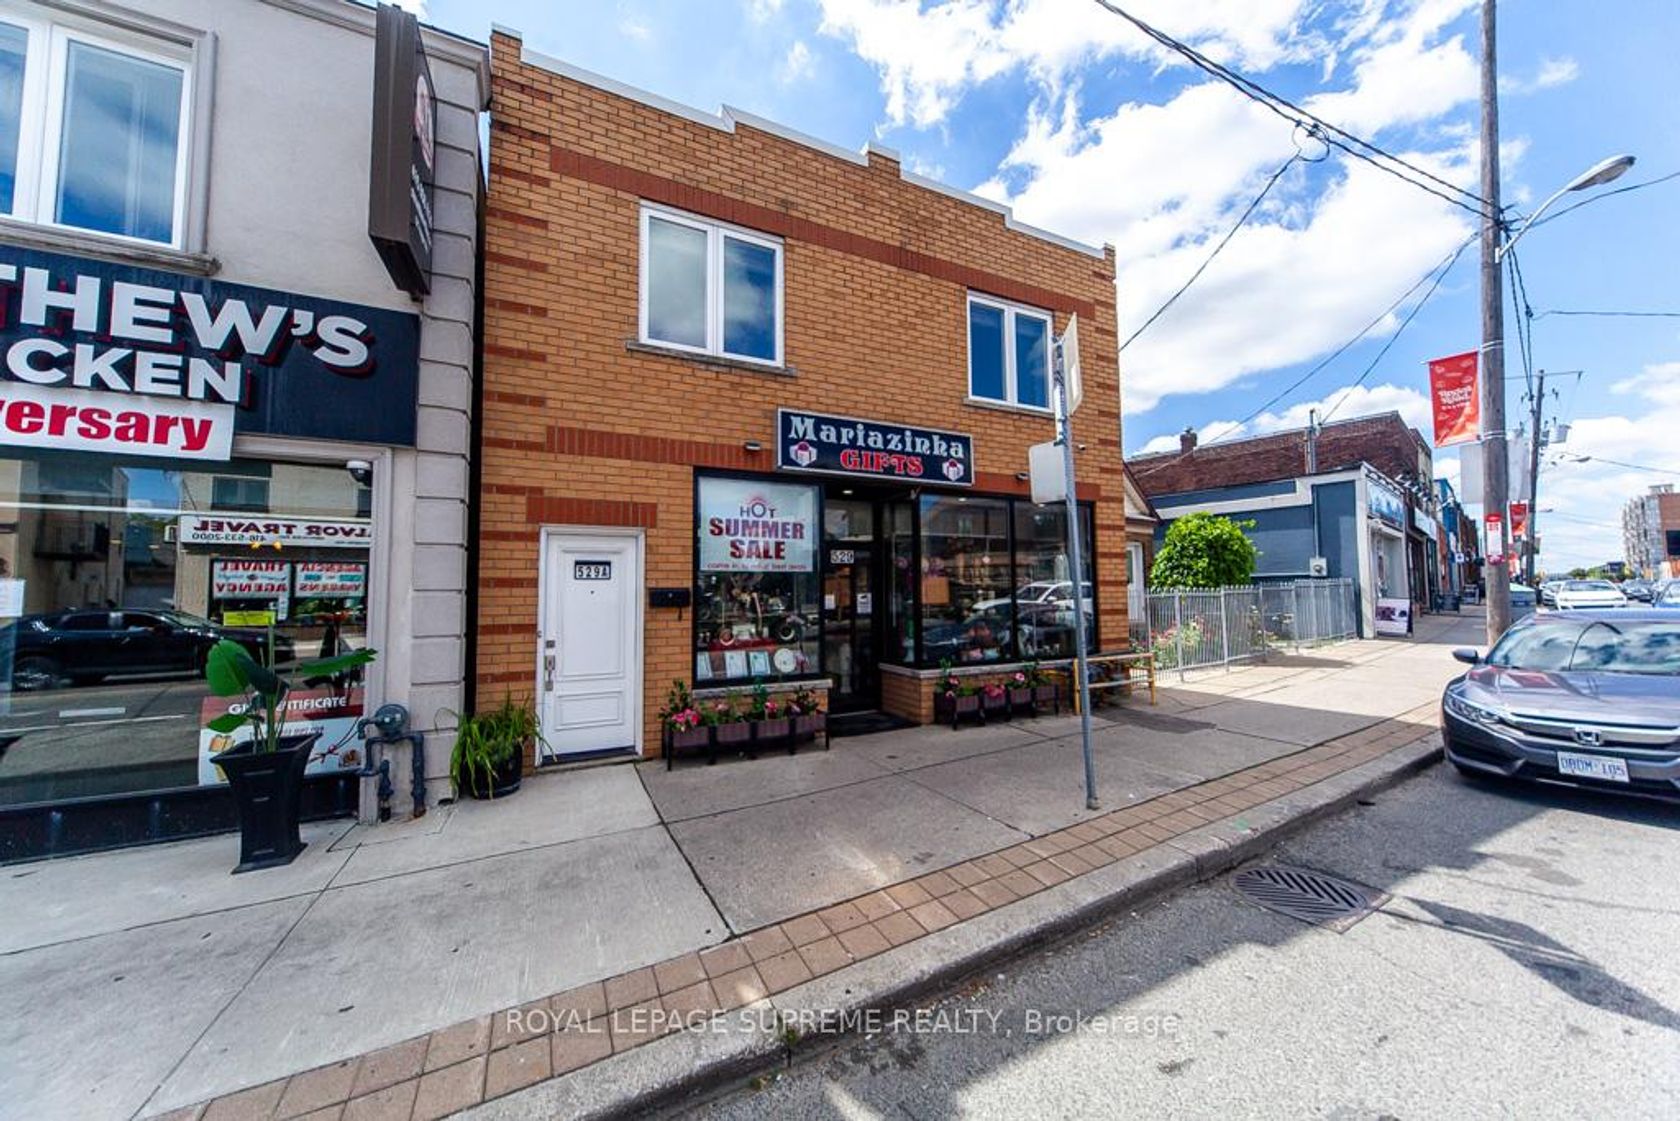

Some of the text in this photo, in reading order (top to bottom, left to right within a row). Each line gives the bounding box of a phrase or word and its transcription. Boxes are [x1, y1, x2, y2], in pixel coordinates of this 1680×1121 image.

[0, 399, 213, 451] ersary
[788, 415, 965, 459] Mariazinha
[840, 449, 924, 477] GIFTS
[740, 502, 777, 519] HOT
[709, 517, 805, 540] SUMMER
[730, 539, 786, 561] SALE
[577, 565, 608, 578] 529A
